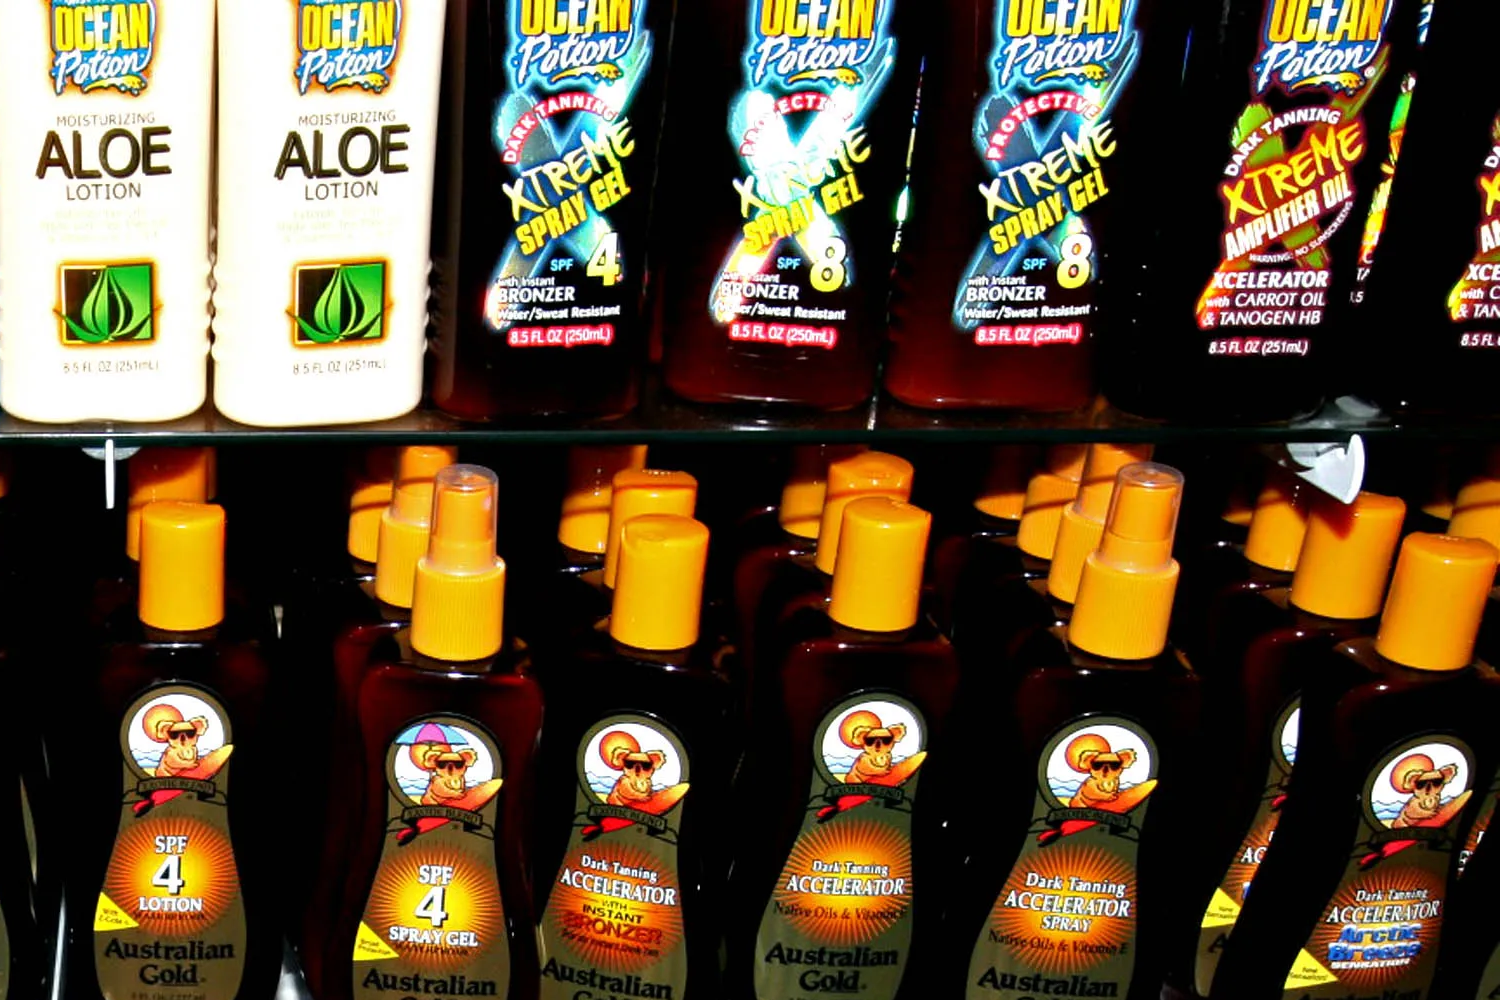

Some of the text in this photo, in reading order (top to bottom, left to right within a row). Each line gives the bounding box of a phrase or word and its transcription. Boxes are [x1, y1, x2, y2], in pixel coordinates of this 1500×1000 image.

[55, 2, 150, 51] OCEAN
[52, 49, 147, 95] Potion
[1256, 41, 1372, 93] Potion
[56, 112, 156, 127] MOISTURIZING
[986, 91, 1103, 161] PROTECTIVE
[35, 126, 173, 179] ALOE
[1225, 108, 1341, 177] DARK TANNING
[501, 116, 636, 221] XTREME
[979, 120, 1116, 220] XTREME
[1222, 122, 1364, 223] XTREME
[65, 183, 142, 200] LOTION
[515, 162, 630, 256] SPRAY GEL
[989, 168, 1109, 255] SPRAY GEL
[1224, 189, 1319, 261] AMPLIFIER
[1320, 171, 1352, 211] OIL
[550, 258, 573, 272] SPF
[586, 232, 620, 287] 4
[1023, 257, 1047, 271] SPF
[1057, 233, 1093, 288] 8
[1211, 270, 1328, 289] XCELERATOR
[499, 285, 575, 303] BRONZER
[966, 285, 1046, 302] BRONZER
[1206, 291, 1326, 307] with CARROT OIL
[498, 304, 620, 321] Water/Sweat Resistant
[1202, 310, 1321, 326] & TANOGEN HB
[976, 325, 1080, 344] 8.5 FL OZ (250mL)
[581, 855, 658, 883] Dark Tanning
[560, 868, 676, 906] ACCELERATOR
[1026, 872, 1126, 898] Dark Tanning
[138, 897, 203, 912] LOTION
[582, 903, 644, 924] INSTANT
[1004, 890, 1130, 916] ACCELERATOR
[1326, 900, 1441, 924] ACCELERATOR
[563, 912, 663, 945] BRONZER
[1041, 916, 1092, 932] SPRAY
[1338, 923, 1422, 943] Arctic
[1328, 941, 1422, 961] Breeze
